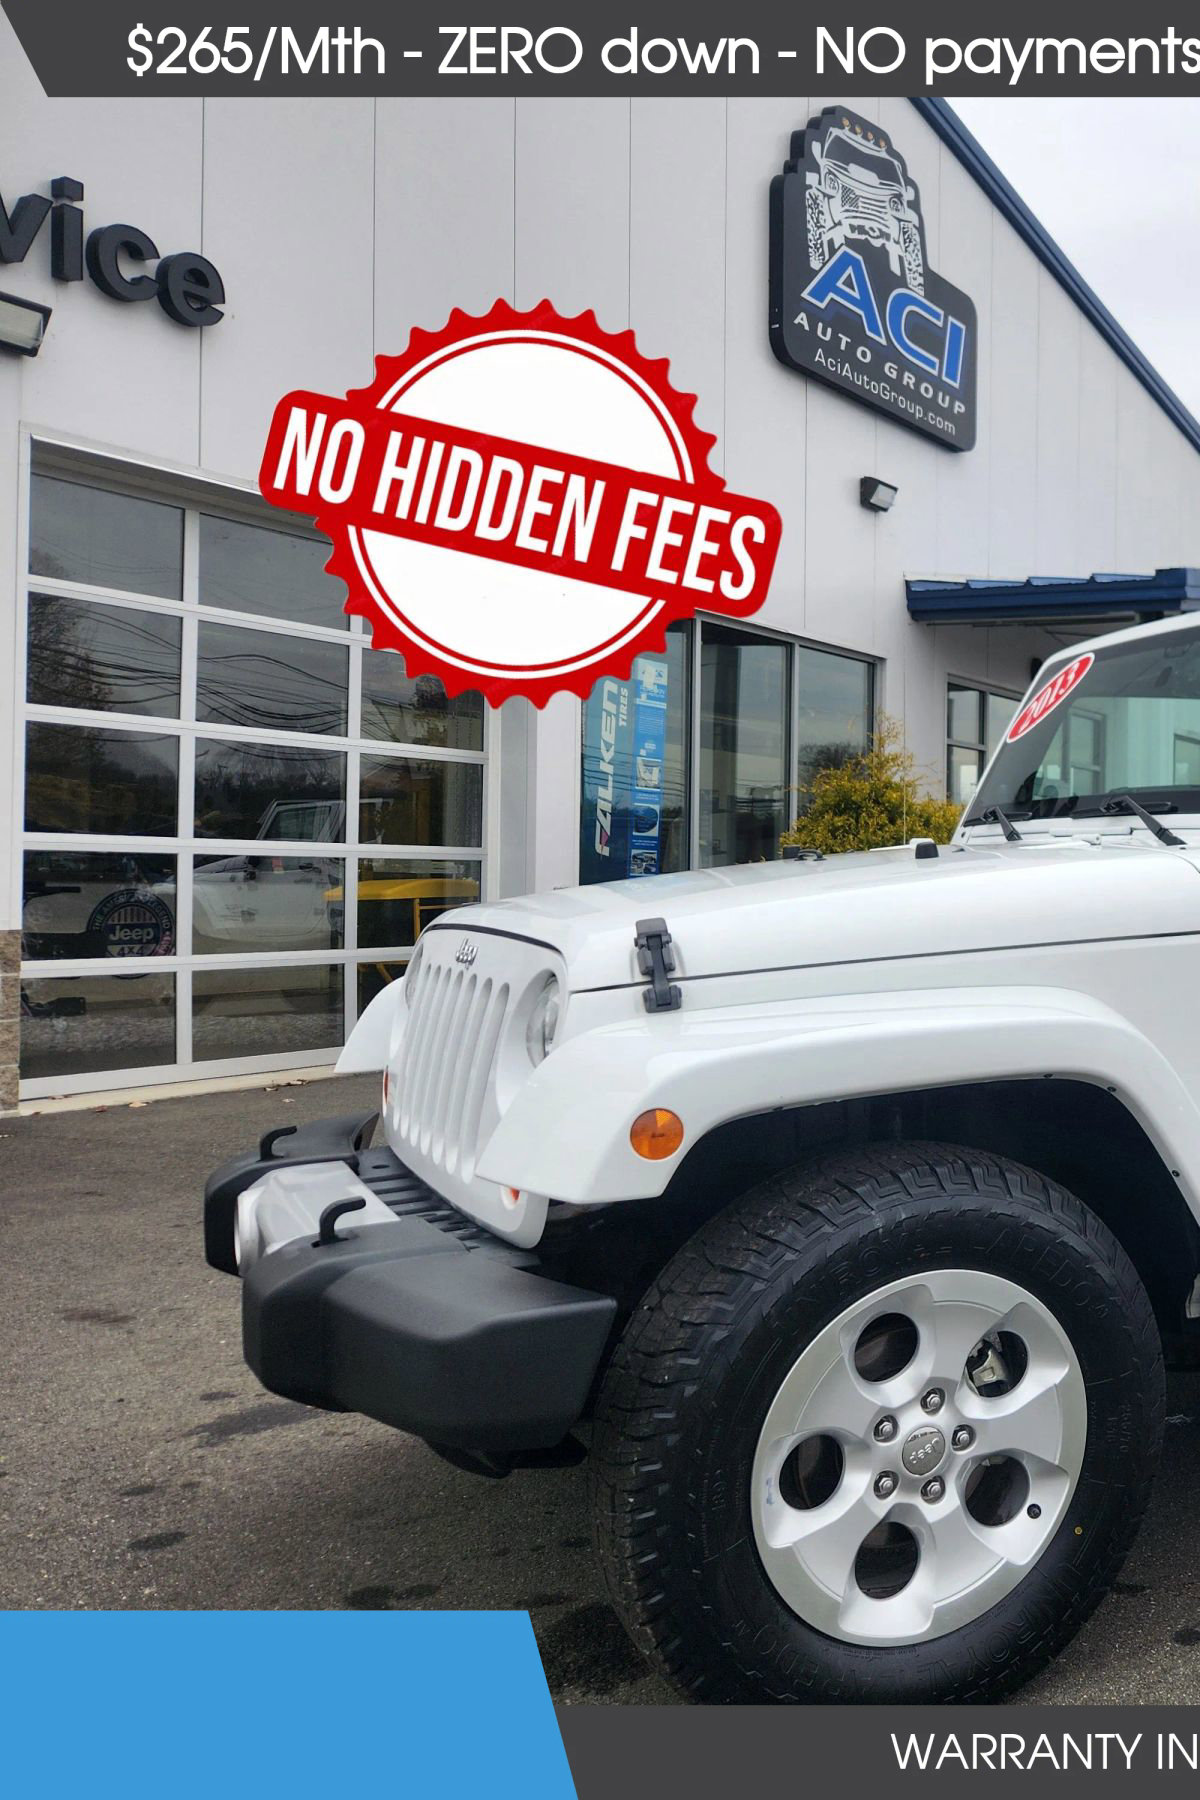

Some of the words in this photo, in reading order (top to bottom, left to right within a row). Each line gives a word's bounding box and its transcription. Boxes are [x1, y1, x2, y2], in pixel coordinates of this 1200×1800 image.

[0, 176, 225, 328] vice
[793, 311, 872, 364] AUTO
[884, 362, 966, 415] GROUP
[800, 244, 966, 388] ACI
[814, 348, 956, 436] AciAutoGroup.com
[618, 687, 629, 727] TIRES
[1018, 662, 1080, 734] 2013
[595, 681, 618, 857] FALKEN
[109, 925, 154, 943] Jeep
